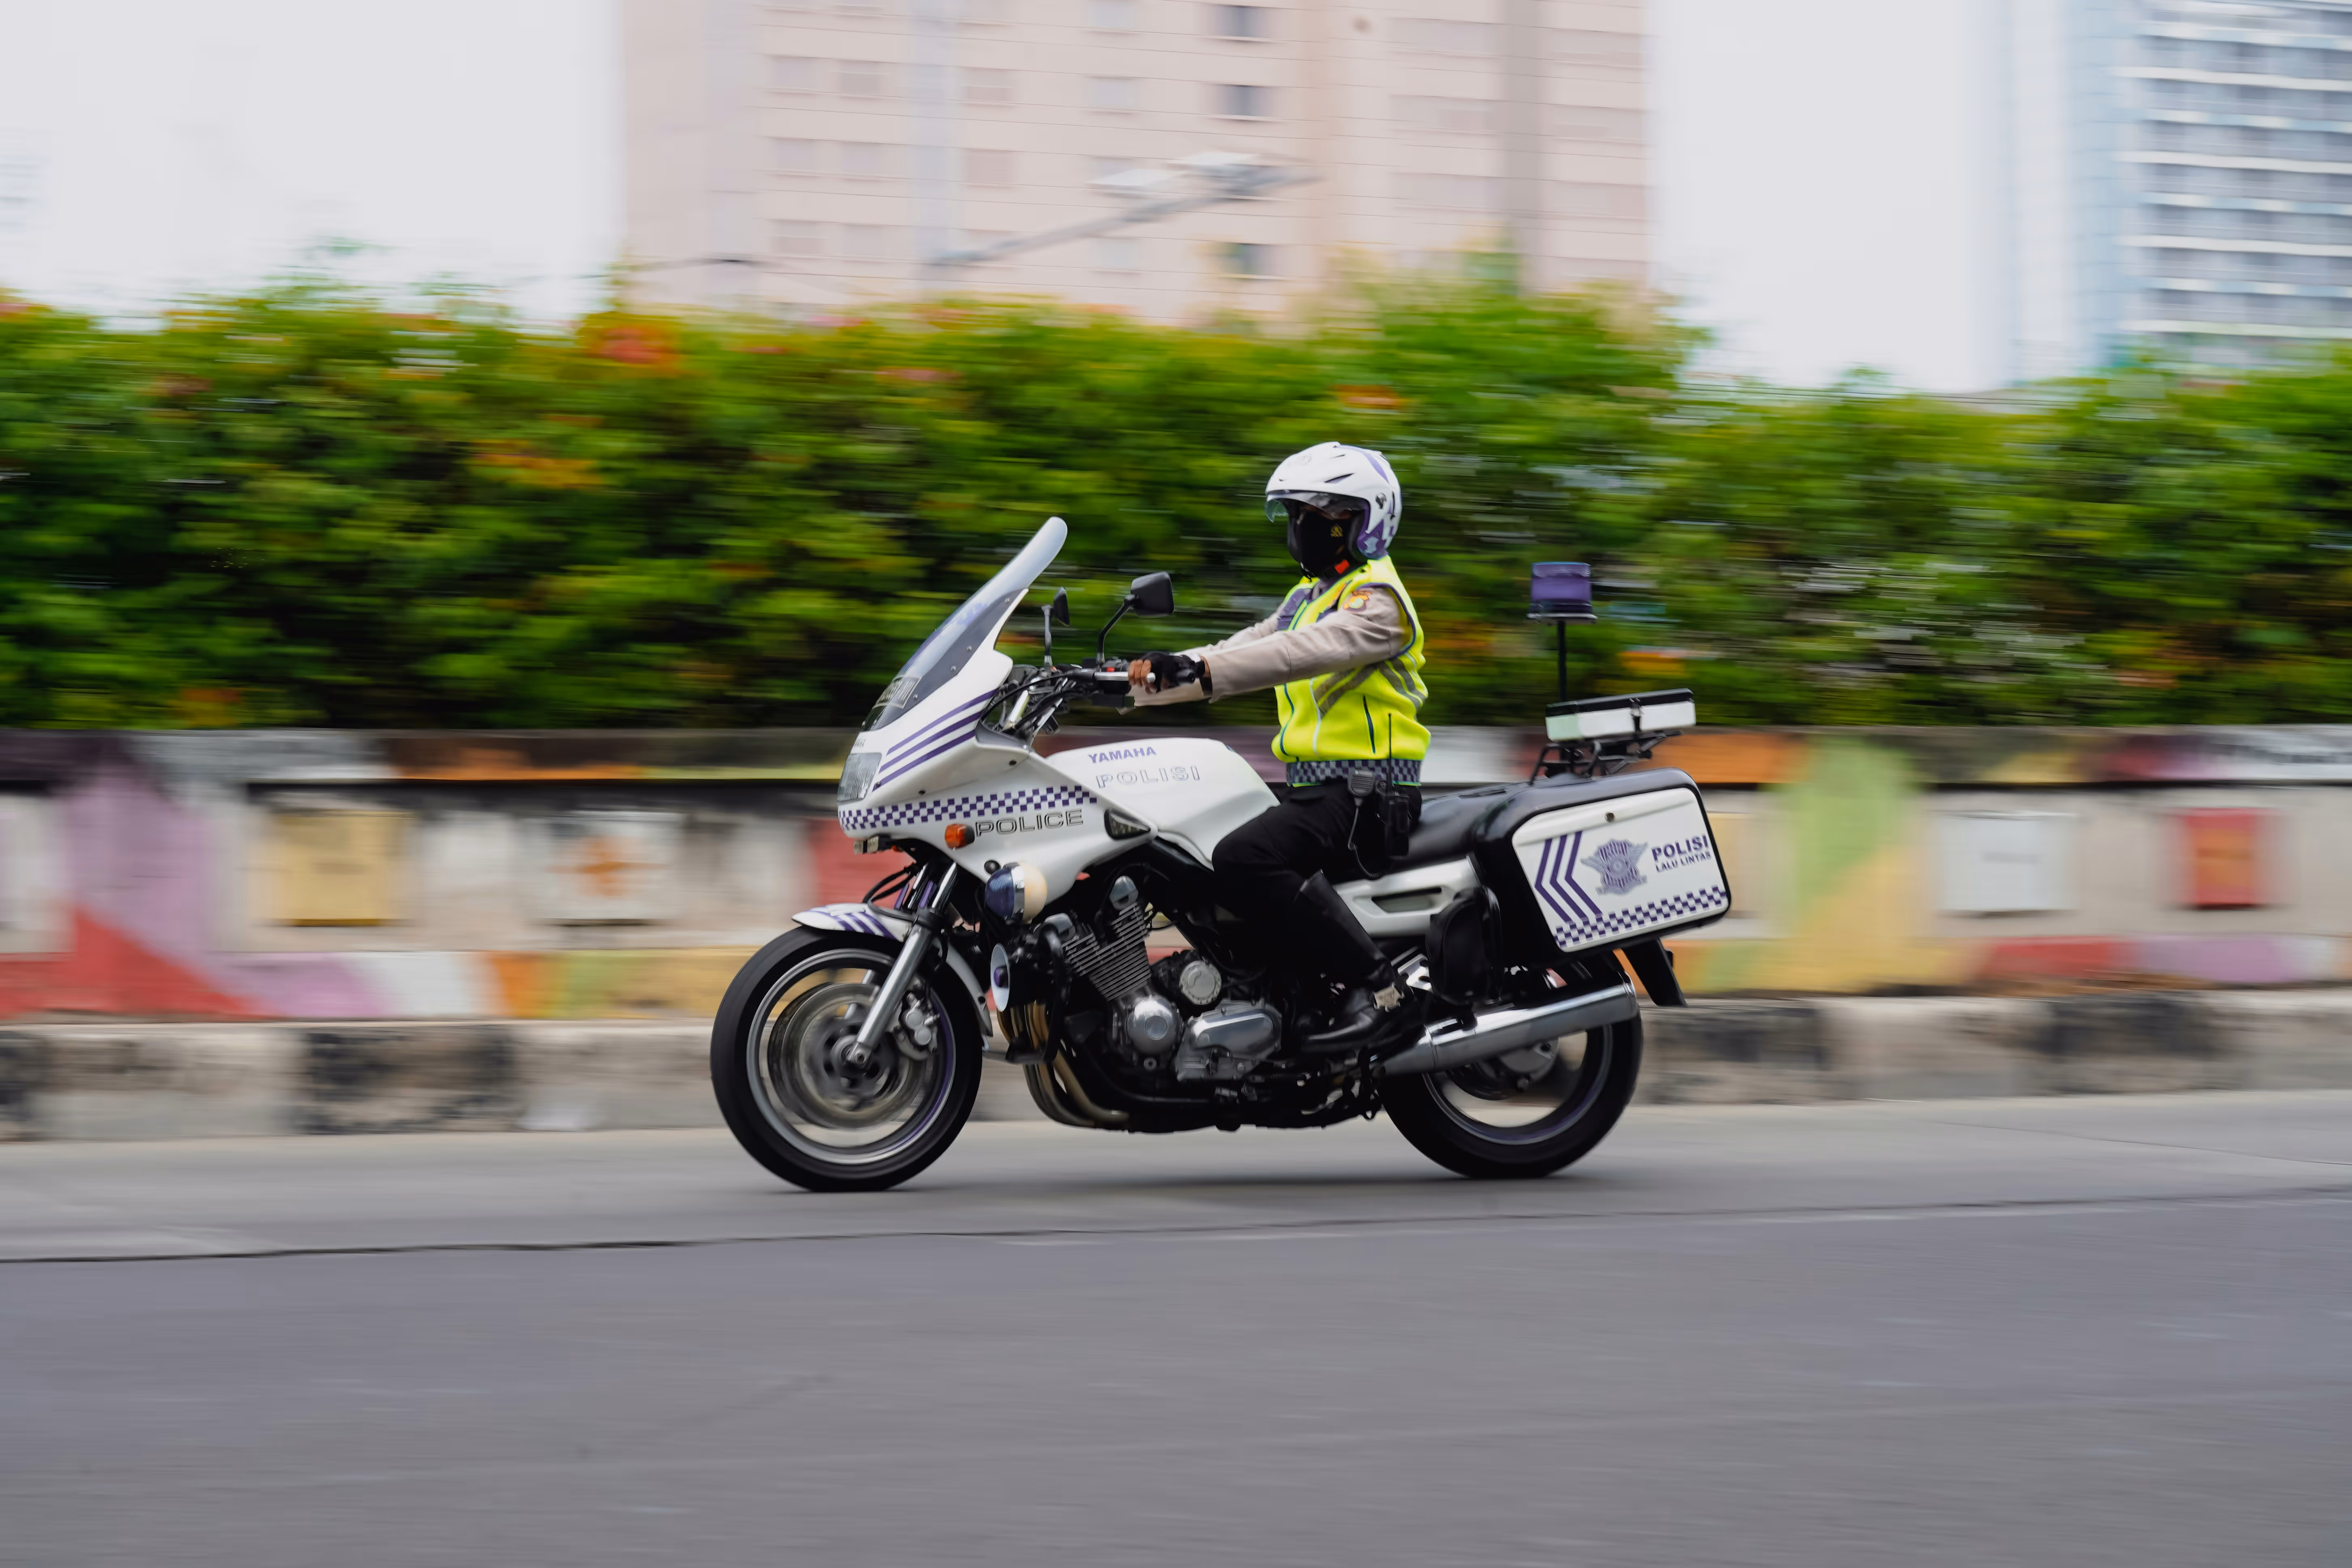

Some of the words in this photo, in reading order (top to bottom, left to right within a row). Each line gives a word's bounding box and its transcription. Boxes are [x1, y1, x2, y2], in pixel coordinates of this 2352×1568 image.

[1088, 747, 1157, 764] YAMAHA
[1095, 765, 1200, 789] POLISI
[975, 808, 1084, 837] POLICE
[1651, 834, 1709, 862] POLISI
[1655, 859, 1679, 873] LALU
[1680, 851, 1712, 866] LINTAS
